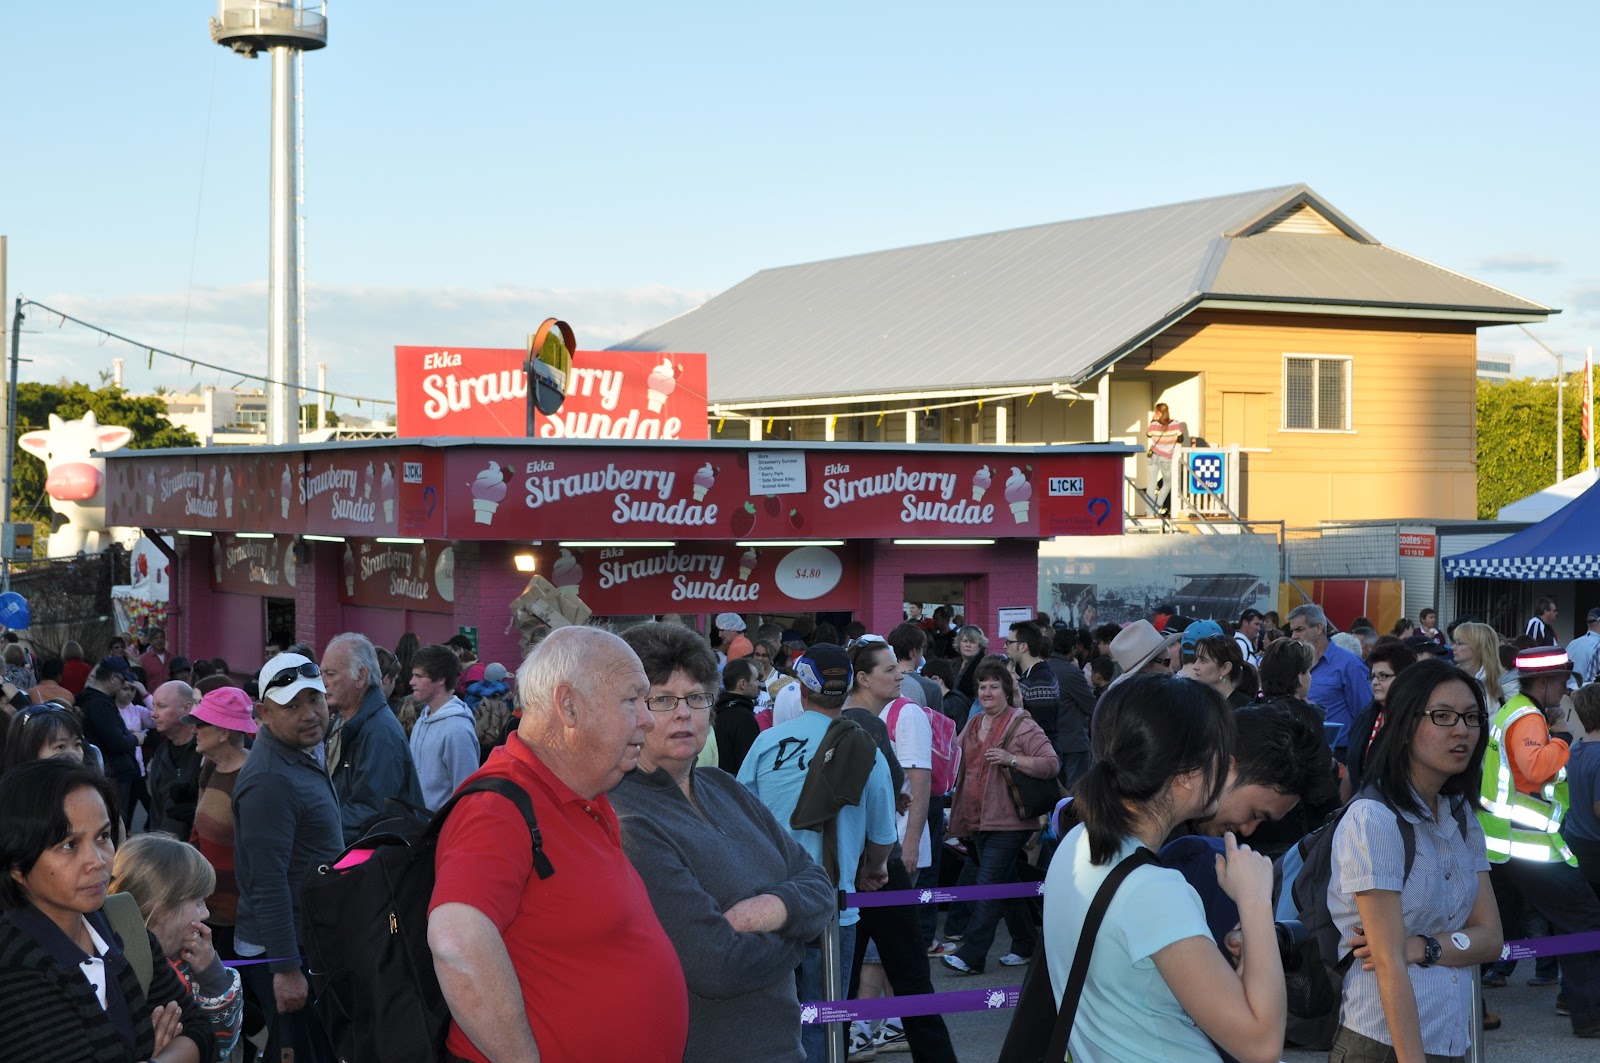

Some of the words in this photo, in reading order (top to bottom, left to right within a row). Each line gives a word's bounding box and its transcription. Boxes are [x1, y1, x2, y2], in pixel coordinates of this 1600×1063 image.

[424, 351, 462, 370] Ekka
[422, 367, 624, 421] Strawrry
[526, 460, 555, 473] Ekka
[824, 463, 850, 476] Ekka
[298, 464, 358, 506] Strawberry
[525, 463, 676, 509] Strawberry
[823, 466, 957, 509] Strawberry
[1196, 480, 1218, 489] Plice
[185, 490, 218, 518] Sundae
[331, 491, 376, 522] Sundae
[612, 492, 719, 526] Sundae
[900, 494, 995, 525] Sundae
[360, 546, 412, 581] Strawberry
[598, 549, 725, 589] Strawberry
[600, 548, 625, 560] Ekka
[390, 571, 429, 600] Sundae
[671, 574, 761, 602] Sundae
[795, 567, 822, 579] $4.80
